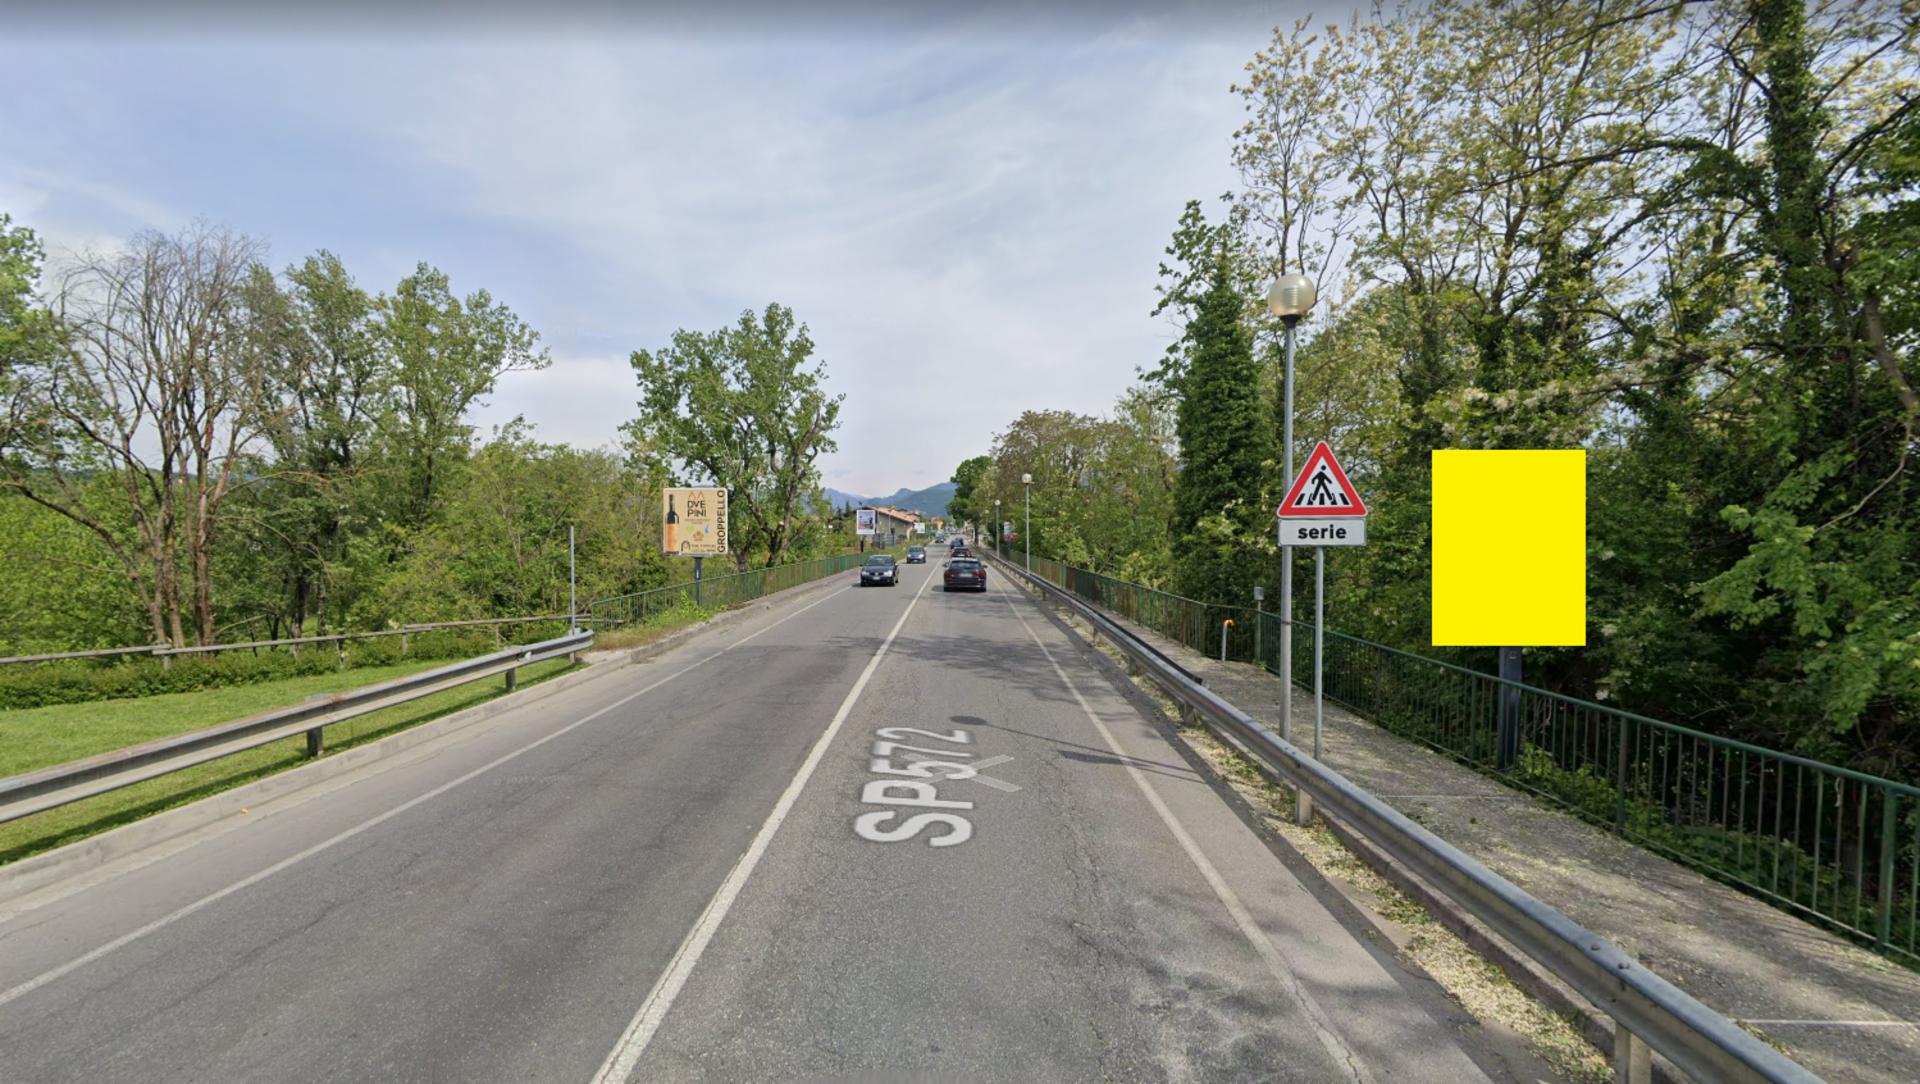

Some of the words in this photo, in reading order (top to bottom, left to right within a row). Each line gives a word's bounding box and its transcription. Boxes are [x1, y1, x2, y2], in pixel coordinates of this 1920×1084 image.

[687, 509, 707, 517] PINI
[716, 490, 726, 553] GROPPELLO
[1297, 524, 1347, 539] serie
